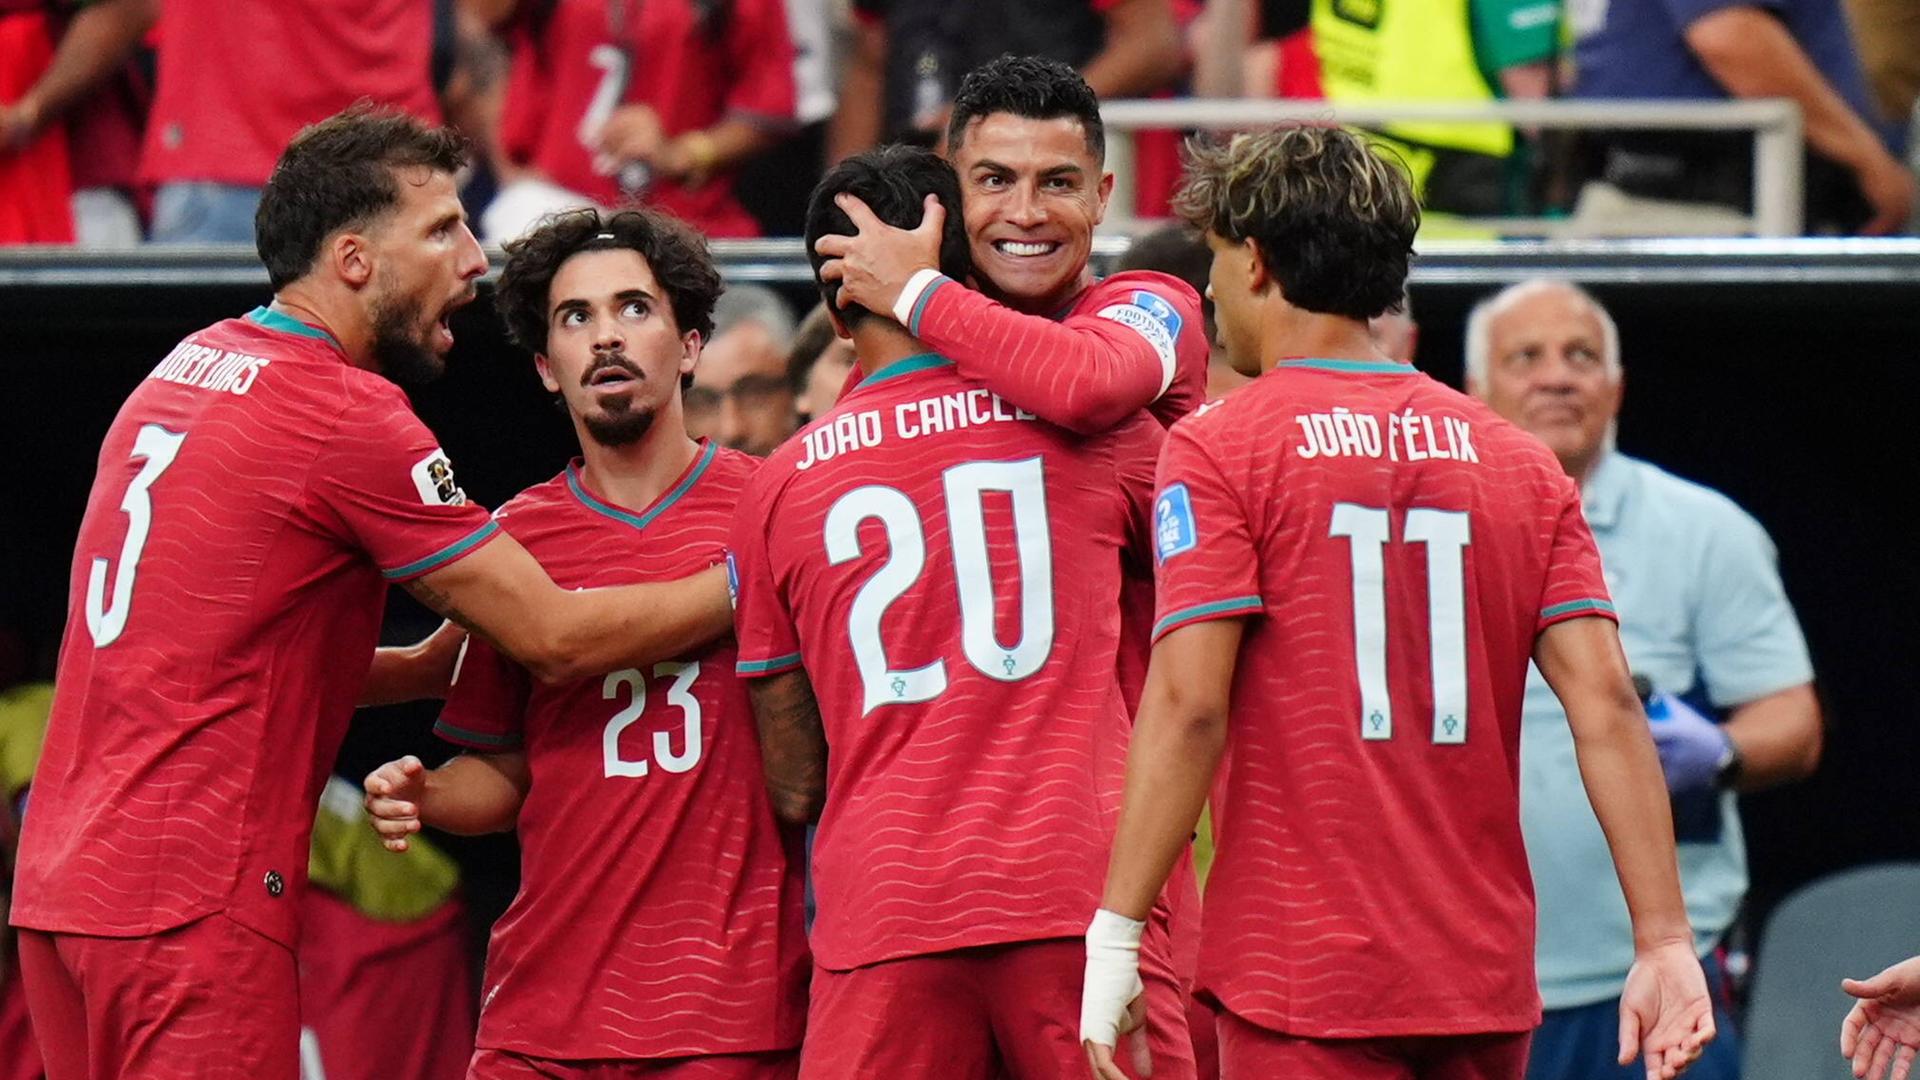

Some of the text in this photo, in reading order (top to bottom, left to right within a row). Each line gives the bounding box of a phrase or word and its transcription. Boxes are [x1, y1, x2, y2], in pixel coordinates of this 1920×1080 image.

[199, 351, 271, 395] DIAS
[796, 410, 883, 470] JOÃO
[1295, 406, 1479, 463] JOÃO FÉLIX
[85, 423, 189, 648] 3
[823, 454, 1056, 719] 20
[1328, 501, 1471, 744] 11
[602, 660, 702, 778] 23
